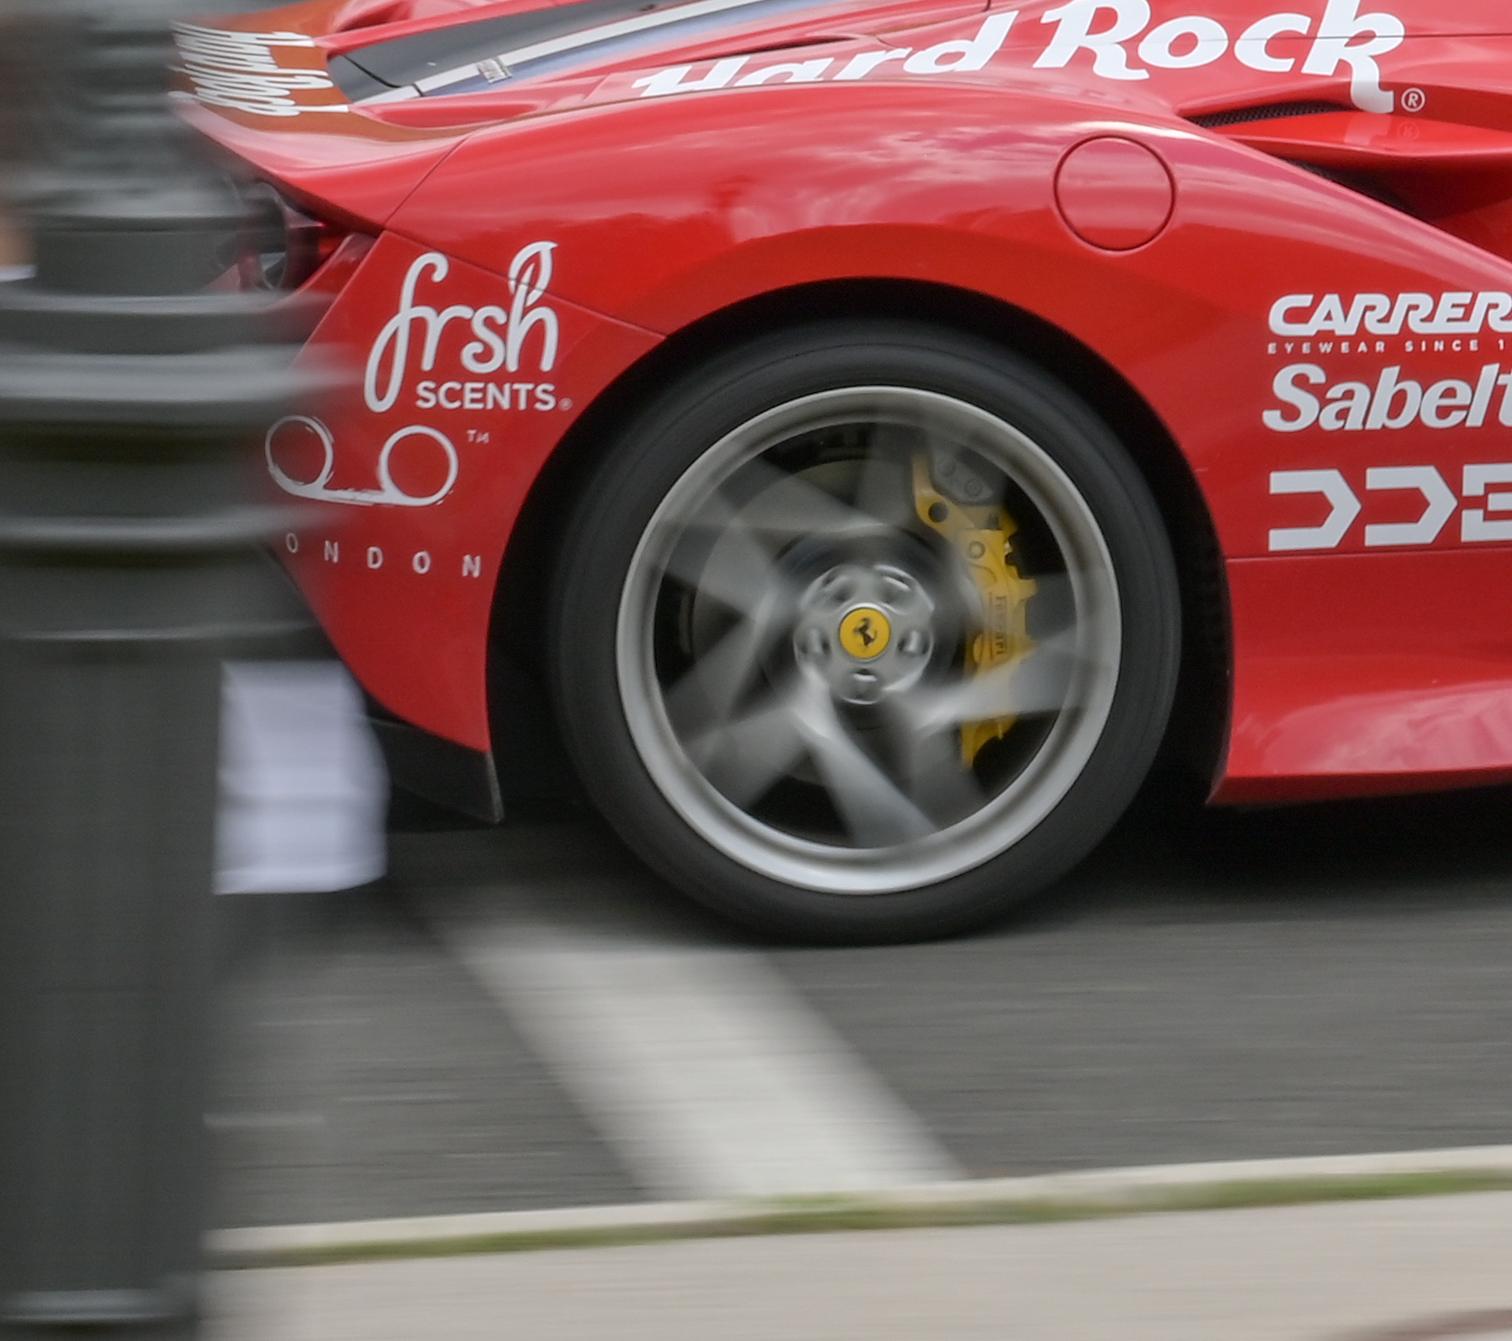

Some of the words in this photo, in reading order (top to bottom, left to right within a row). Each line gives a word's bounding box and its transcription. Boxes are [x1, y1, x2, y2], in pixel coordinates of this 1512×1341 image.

[364, 241, 558, 412] frsh
[1267, 341, 1386, 354] EYEWEAR
[1405, 339, 1479, 352] SINCE
[416, 381, 556, 411] SCENTS
[285, 532, 481, 578] ONDON
